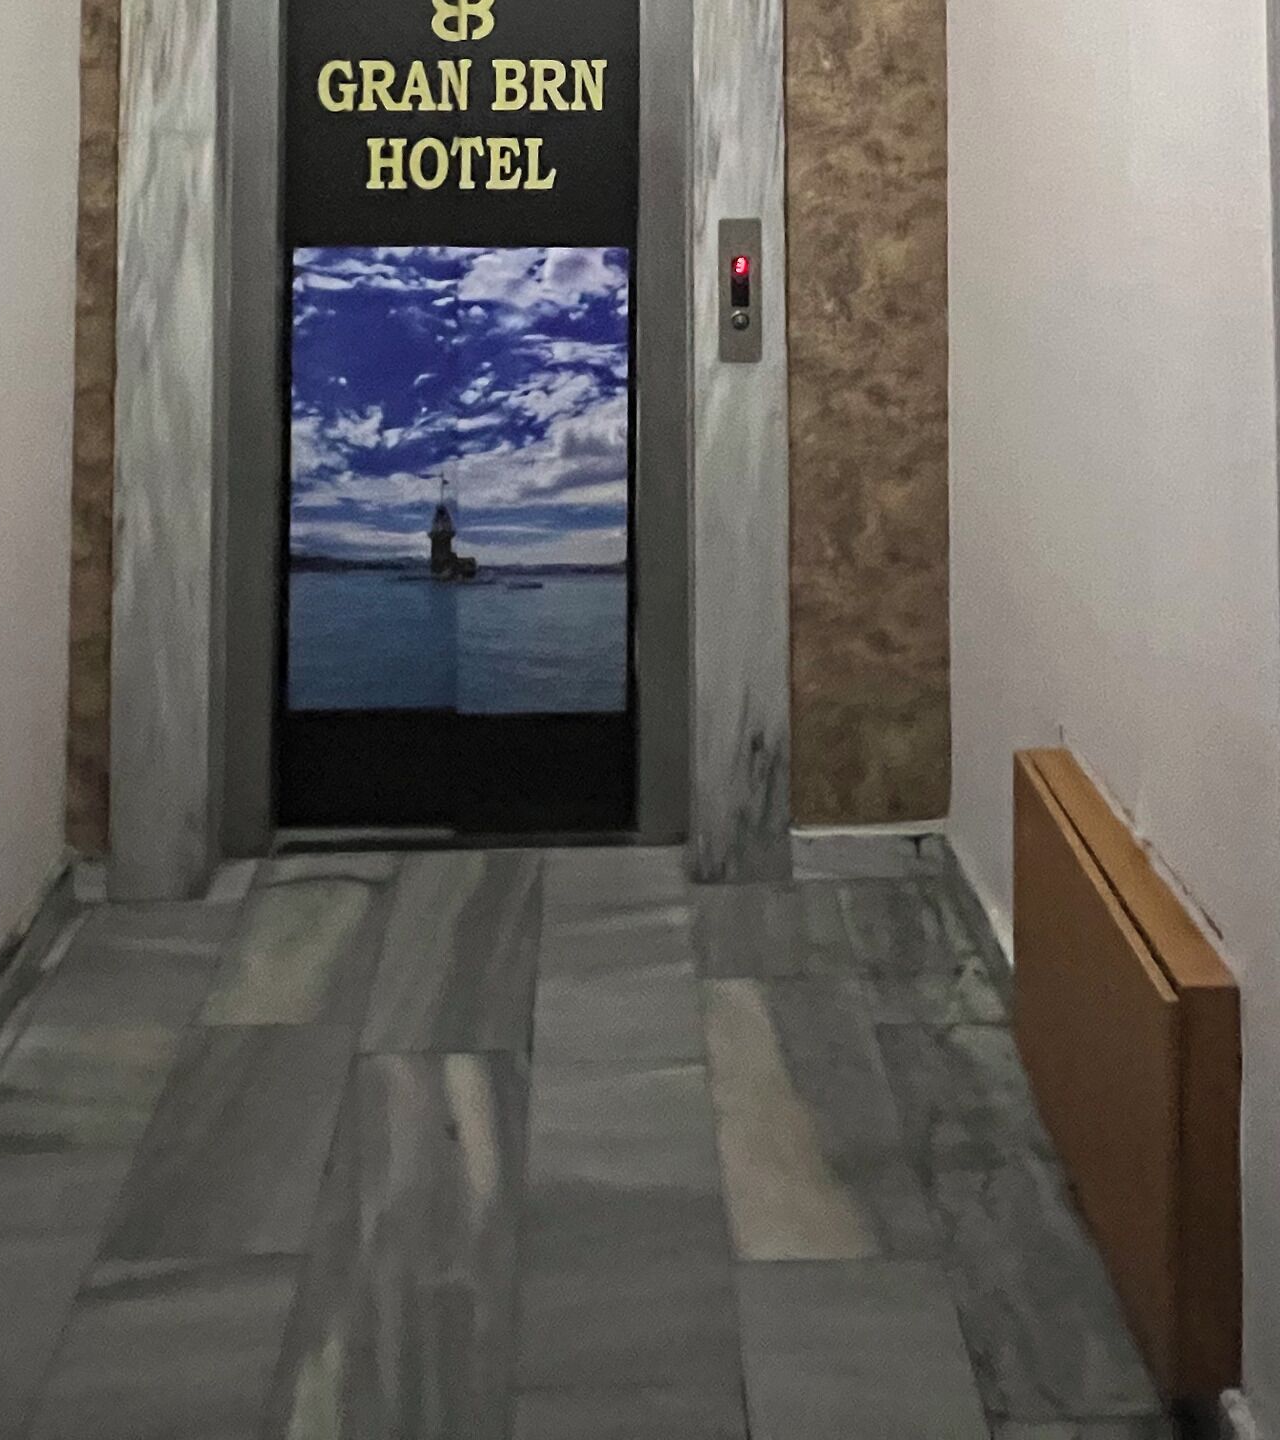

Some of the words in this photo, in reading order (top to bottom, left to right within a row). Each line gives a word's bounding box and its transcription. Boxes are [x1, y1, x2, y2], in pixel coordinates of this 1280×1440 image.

[317, 58, 473, 112] GRAN
[491, 58, 608, 111] BRN
[365, 135, 557, 190] HOTEL
